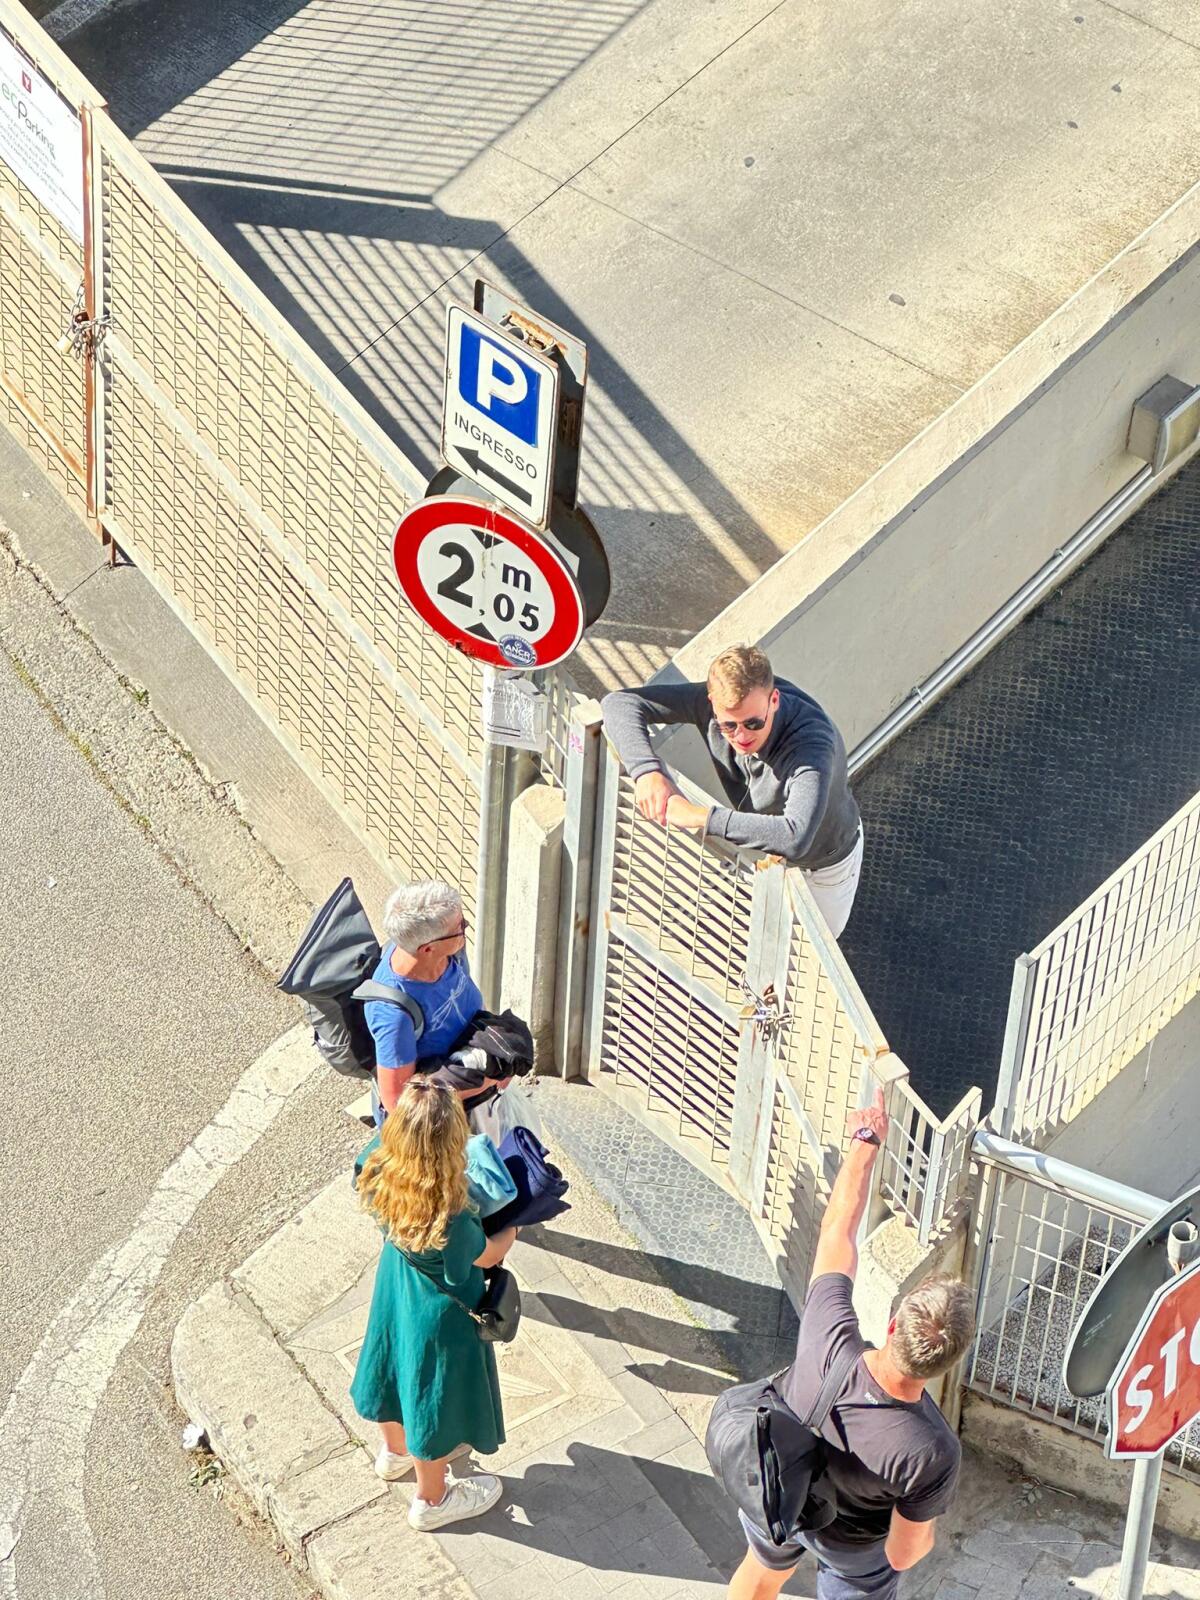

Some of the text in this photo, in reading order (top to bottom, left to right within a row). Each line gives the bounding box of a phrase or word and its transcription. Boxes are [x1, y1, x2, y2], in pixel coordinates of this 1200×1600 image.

[476, 337, 528, 411] P
[454, 411, 537, 480] INGRESSO
[502, 561, 531, 593] m
